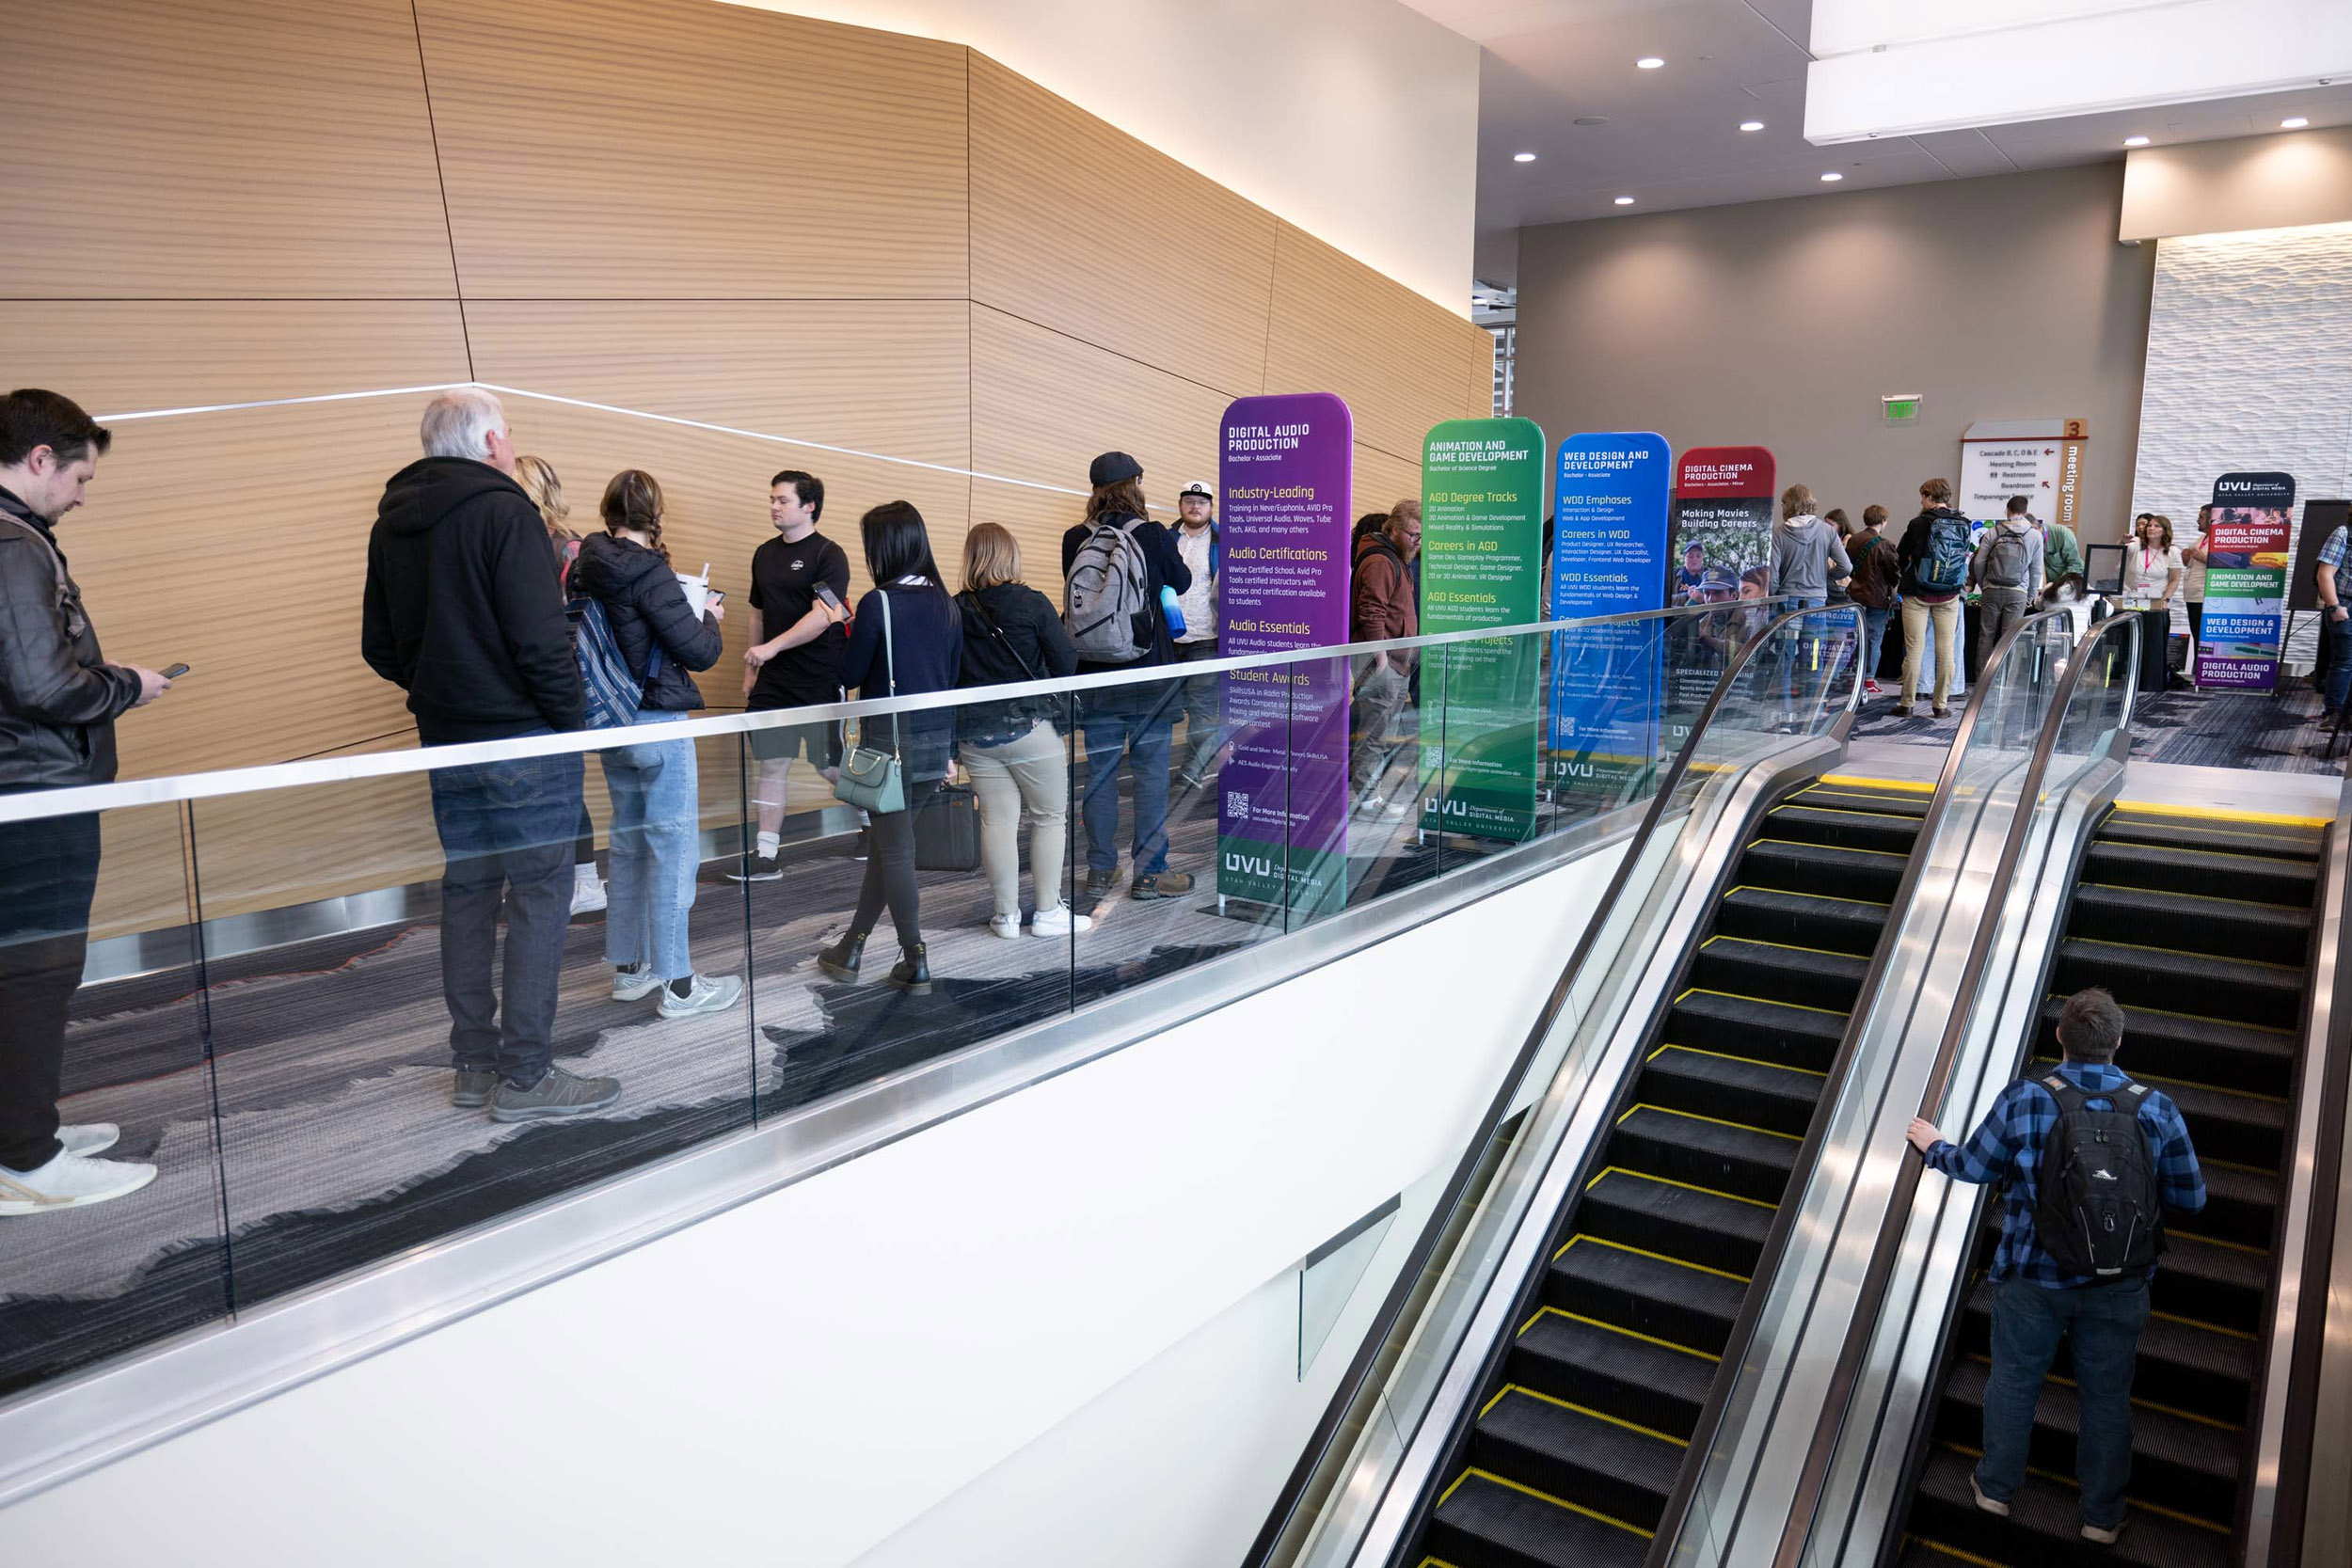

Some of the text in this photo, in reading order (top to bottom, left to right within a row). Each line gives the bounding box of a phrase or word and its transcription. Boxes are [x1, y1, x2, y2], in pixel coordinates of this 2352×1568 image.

[1888, 402, 1915, 419] EXIT
[1229, 424, 1309, 438] DIGITAL AUDIO
[2069, 421, 2080, 436] 3
[1229, 438, 1298, 451] PRODUCTION
[1430, 440, 1505, 451] ANIMATION AND
[1430, 450, 1528, 462] GAME DEVELOPMENT
[1565, 451, 1648, 461] WEB DESIGN AND
[1565, 461, 1634, 469] DEVELOPMENT
[1720, 464, 1753, 472] CINEMA
[1685, 472, 1738, 481] PRODUCTION
[2062, 446, 2077, 521] meeting room
[2219, 482, 2251, 491] UVU
[1230, 486, 1314, 500] Industry-Leading
[1429, 492, 1518, 504] AGD Degree Tracks
[1563, 496, 1631, 505] WDD Emphases
[1230, 504, 1251, 513] Training
[1682, 509, 1749, 518] Making Movies
[1682, 520, 1718, 529] Building
[1598, 530, 1606, 538] in
[1609, 531, 1629, 539] WDD
[1429, 541, 1498, 551] Careers in AGD
[1229, 547, 1327, 561] Audio Certifications
[1270, 577, 1301, 585] instructors
[1561, 573, 1628, 582] WDD Essentials
[1263, 588, 1297, 596] certification
[1299, 589, 1326, 598] available
[1428, 593, 1496, 603] AGD Essentials
[1230, 620, 1310, 635] Audio Essentials
[2206, 626, 2273, 635] DEVELOPMENT
[2202, 662, 2238, 671] DIGITAL
[1230, 670, 1269, 682] Student
[2201, 671, 2261, 679] PRODUCTION
[1230, 687, 1255, 695] SkillsUSA
[1263, 689, 1279, 698] Radio
[1230, 697, 1249, 705] Awards
[1251, 698, 1277, 708] Compete
[1298, 704, 1323, 712] Student
[1230, 707, 1248, 716] Mixing
[1230, 718, 1270, 728] Design contest
[1554, 761, 1593, 777] UVU
[1425, 798, 1466, 816] UVU
[1470, 805, 1498, 814] Department
[1277, 810, 1310, 821] Infomation
[1476, 824, 1520, 833] UNIVERSITY
[1226, 853, 1270, 877] UVU
[1274, 872, 1322, 886] DIGTAL MEDIA
